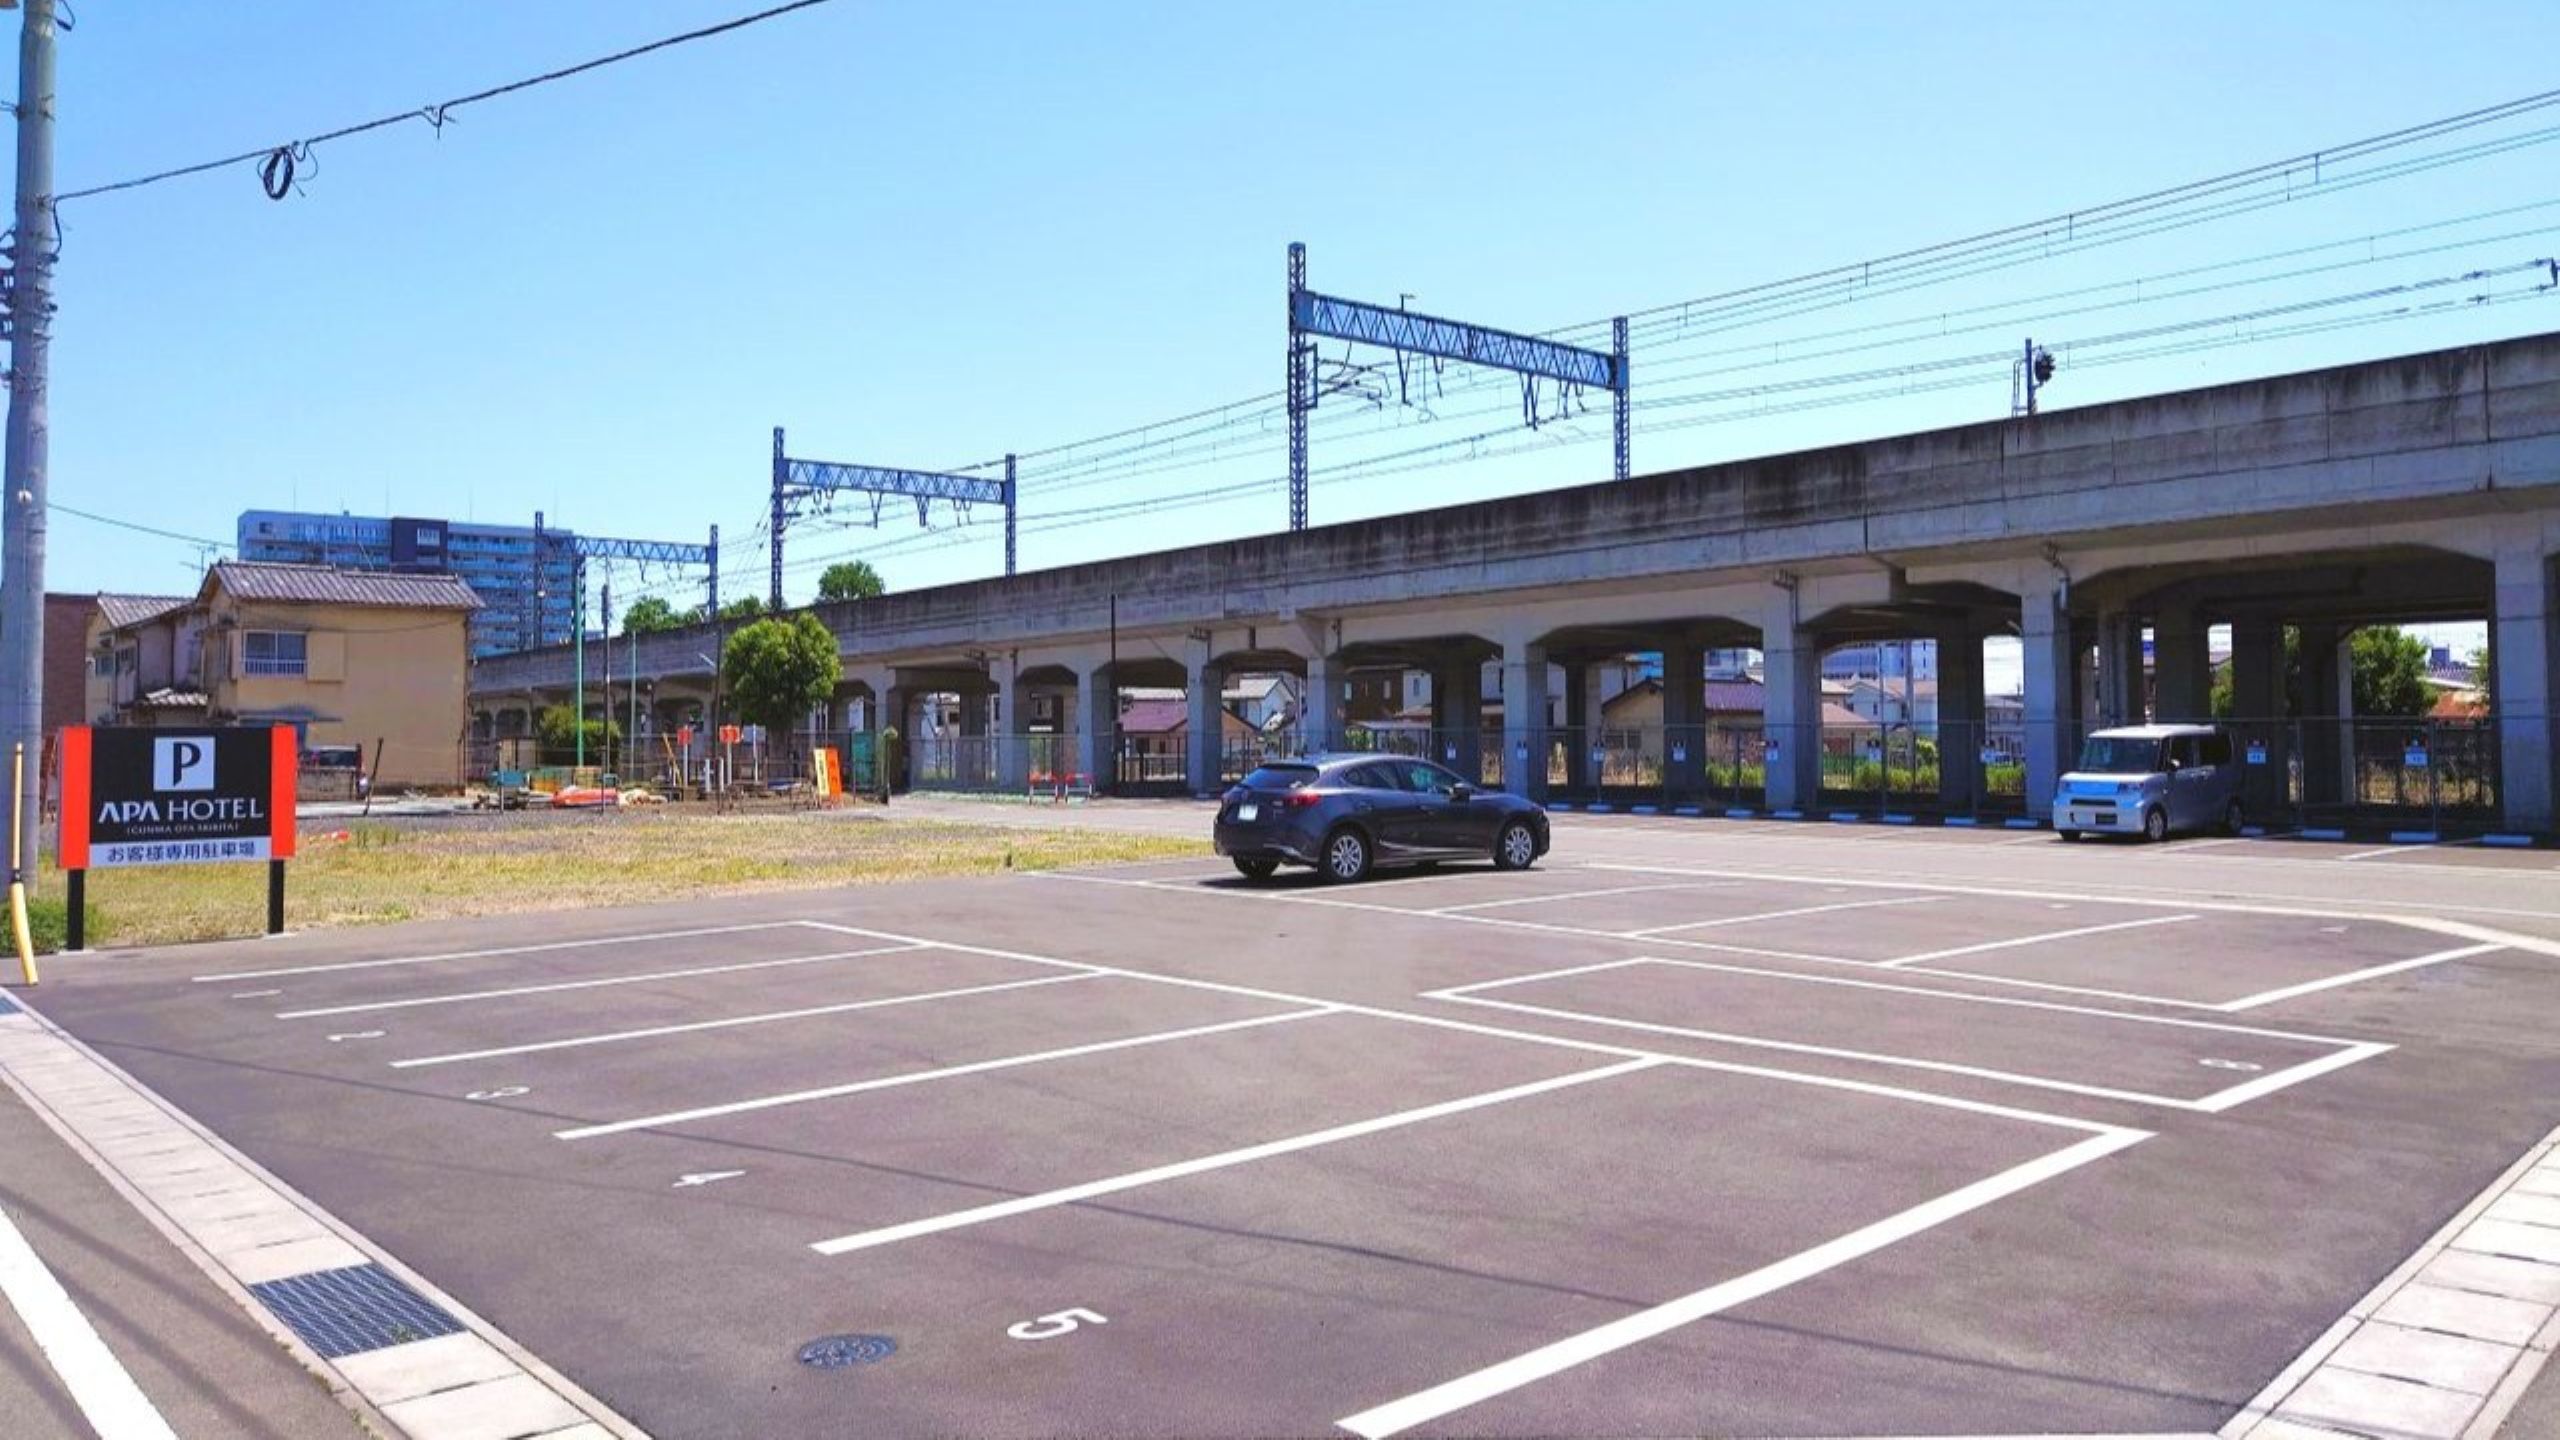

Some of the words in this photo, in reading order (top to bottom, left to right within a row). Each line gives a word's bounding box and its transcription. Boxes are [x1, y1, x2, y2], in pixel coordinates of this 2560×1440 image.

[173, 742, 202, 787] P
[98, 800, 160, 823] APA
[168, 797, 264, 821] HOTEL
[107, 841, 255, 863] お客様専用駐車場
[672, 1169, 747, 1188] 4
[1007, 1307, 1108, 1340] 5
